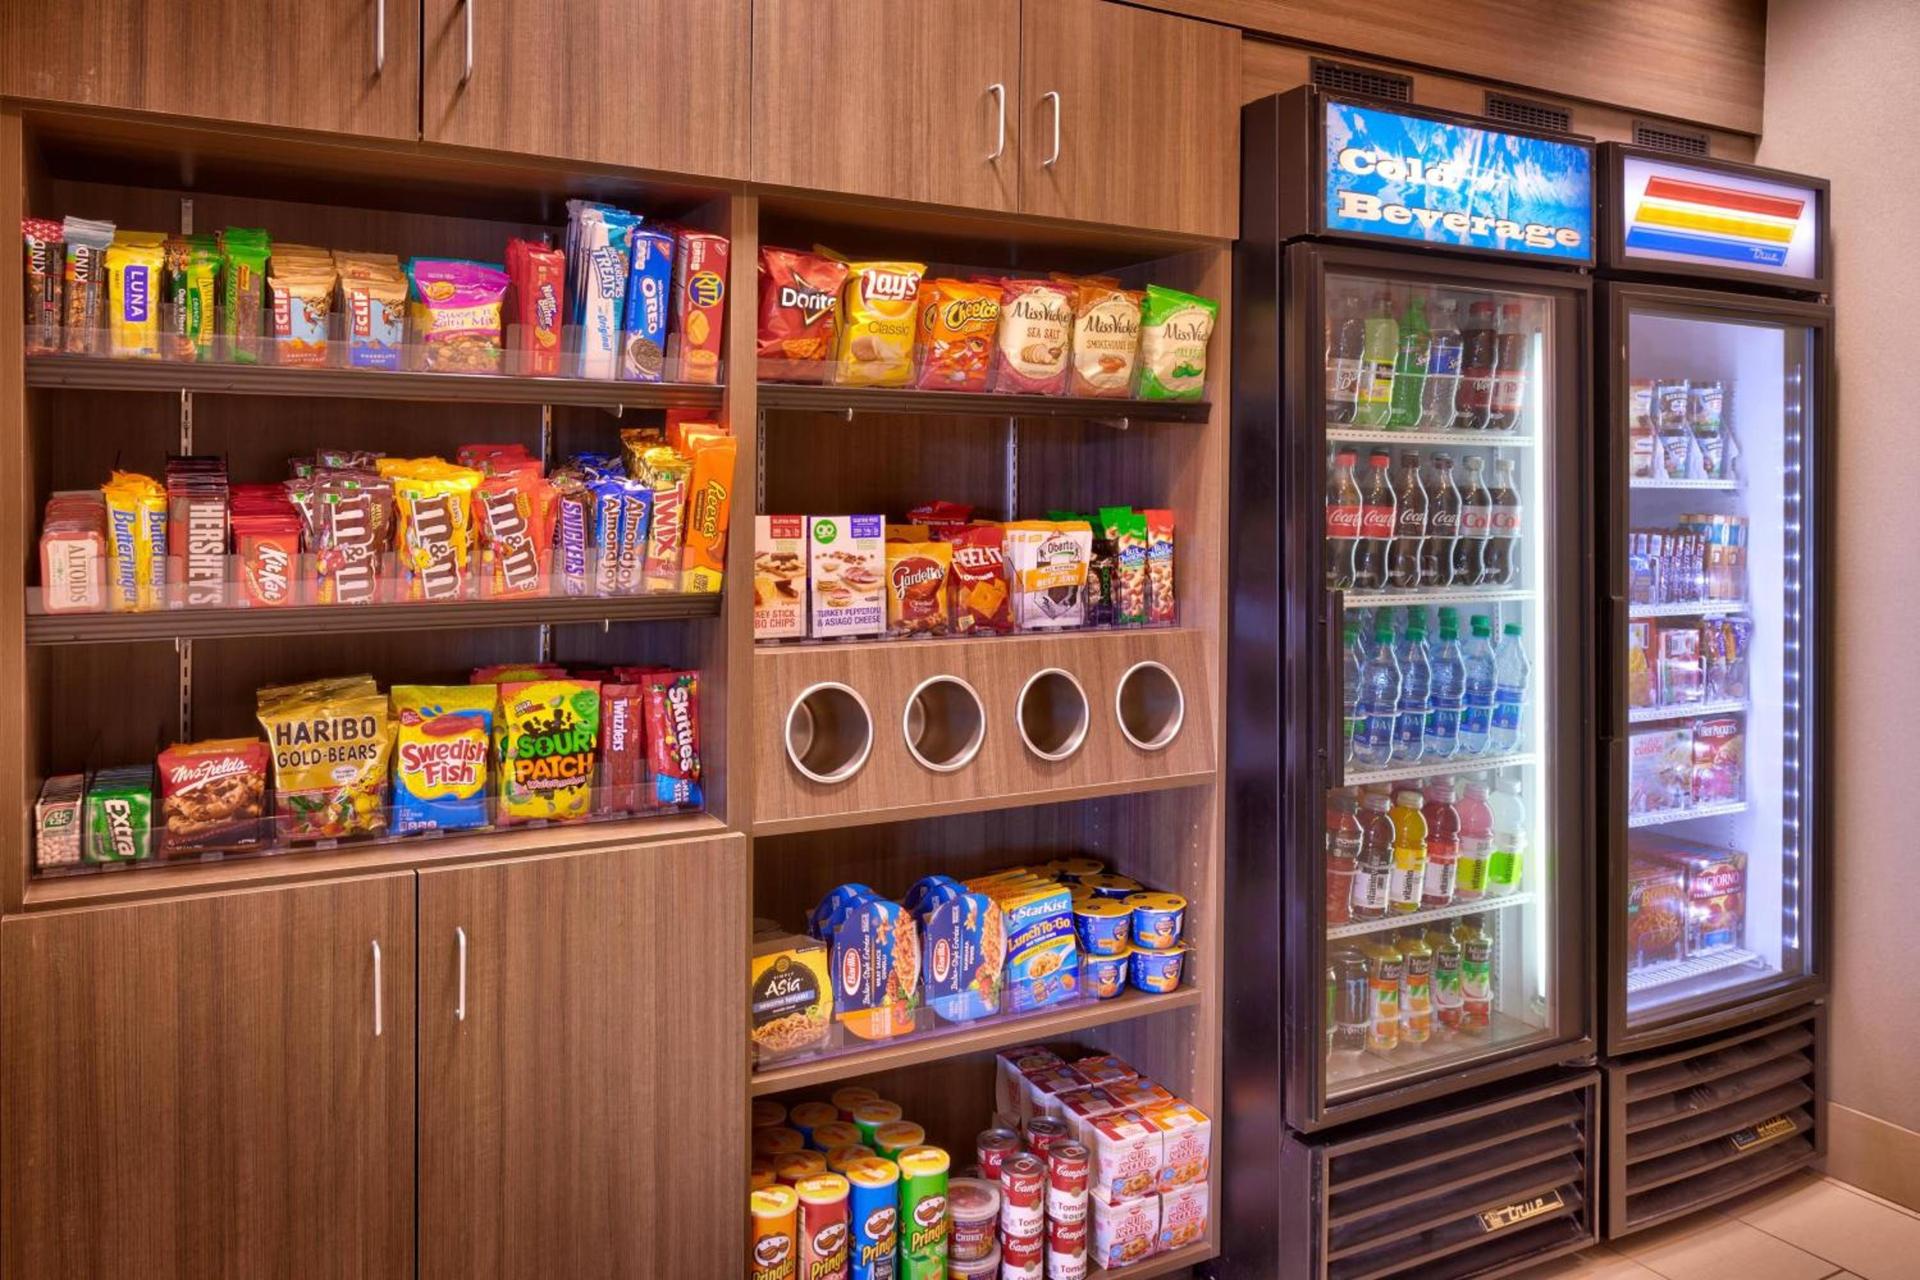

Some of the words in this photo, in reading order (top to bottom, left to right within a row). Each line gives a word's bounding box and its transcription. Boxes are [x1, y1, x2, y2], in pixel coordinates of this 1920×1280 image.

[1338, 146, 1459, 187] Cold
[1337, 189, 1582, 249] Beverage
[32, 239, 45, 275] KIND
[74, 243, 89, 282] KIND
[592, 248, 615, 299] TREATS
[131, 270, 144, 317] LUNA
[695, 272, 721, 307] RITZ
[781, 287, 837, 310] Dorito
[864, 269, 921, 300] Lay's
[274, 290, 289, 325] CLIF
[354, 290, 368, 325] CLIF
[437, 309, 476, 320] Sweet
[641, 276, 658, 334] OREO
[944, 297, 999, 330] Cheetos
[1011, 301, 1042, 321] Miss
[432, 317, 465, 329] Salty
[471, 316, 495, 328] Mix
[597, 314, 612, 352] Original
[867, 320, 910, 337] Classic
[1027, 327, 1042, 339] SEA
[1043, 328, 1061, 340] SALT
[1083, 315, 1111, 334] Miss
[1110, 313, 1138, 338] Vickie
[1163, 322, 1191, 341] Miss
[653, 480, 685, 557] TWIX
[703, 479, 727, 538] Reese's
[485, 487, 538, 591] m&m's
[561, 499, 585, 577] SNICKERS
[603, 494, 621, 565] Almond
[623, 495, 645, 562] Almond
[113, 509, 138, 603] Butterfinger
[188, 504, 225, 606] HERSHEY'S
[411, 492, 462, 599] m&m'
[954, 546, 1003, 568] EEZ-IT
[1047, 541, 1075, 553] Oberto
[69, 544, 88, 603] ALTOIDS
[599, 564, 617, 592] Joy
[618, 560, 634, 588] Joy
[892, 565, 945, 600] Gardetto's
[755, 610, 770, 618] KEY
[772, 609, 796, 618] STICK
[769, 618, 796, 628] CHIPS
[816, 609, 844, 618] TURKEY
[845, 606, 881, 617] PEPPERONI
[825, 617, 852, 626] ASIAGO
[854, 615, 881, 624] CHEESE
[276, 716, 376, 746] HARIBO
[612, 698, 628, 752] Twizzlers
[668, 687, 694, 772] Skittles
[277, 744, 377, 768] GOLD-BEARS
[401, 739, 487, 772] Swedish
[518, 732, 590, 758] SOUR
[199, 758, 252, 780] Fields
[422, 760, 474, 785] Fish
[515, 752, 594, 783] PATCH
[49, 815, 69, 825] tac
[54, 810, 72, 818] tic
[1017, 898, 1069, 918] StarKist
[1007, 925, 1041, 951] Lunch
[1040, 916, 1071, 934] To-Go
[847, 951, 857, 984] Barilla
[936, 943, 946, 973] Barilla
[764, 976, 801, 998] Asia
[1496, 1197, 1545, 1222] true
[862, 1231, 898, 1267] Pringl
[910, 1219, 950, 1252] Pringle
[811, 1244, 848, 1278] Pringl
